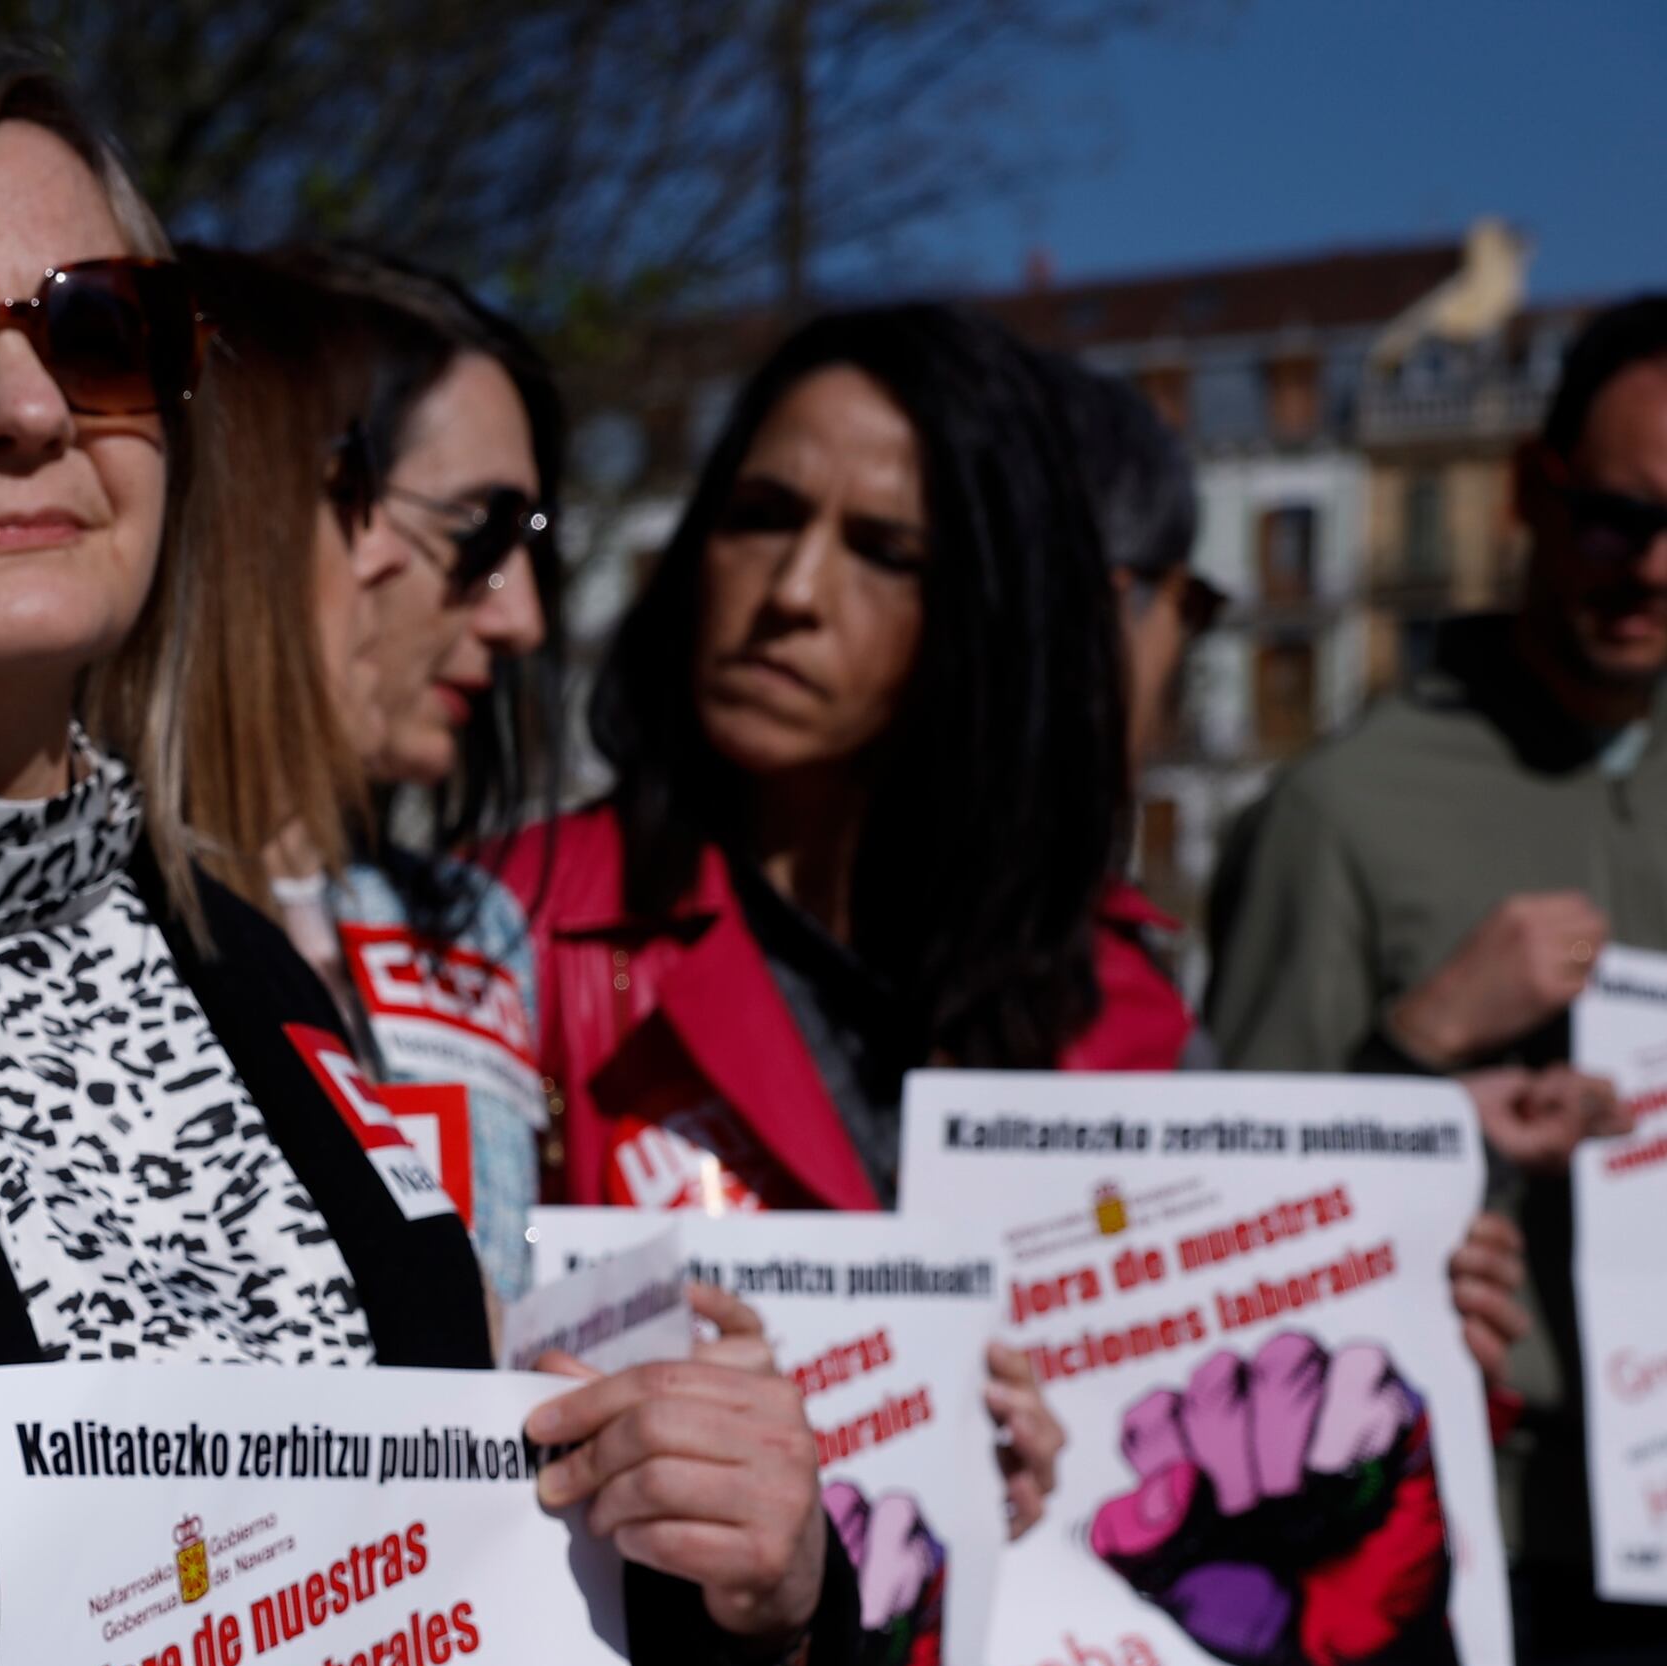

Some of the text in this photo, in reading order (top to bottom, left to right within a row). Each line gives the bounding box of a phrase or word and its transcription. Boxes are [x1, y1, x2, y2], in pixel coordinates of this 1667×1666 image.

[1011, 1264, 1101, 1324] jora
[1113, 1246, 1165, 1292] de
[1177, 1183, 1353, 1273] nuestras
[15, 1421, 229, 1479] Kalitatezko
[238, 1423, 370, 1478] zerbitzu
[250, 1520, 429, 1660] nuestras
